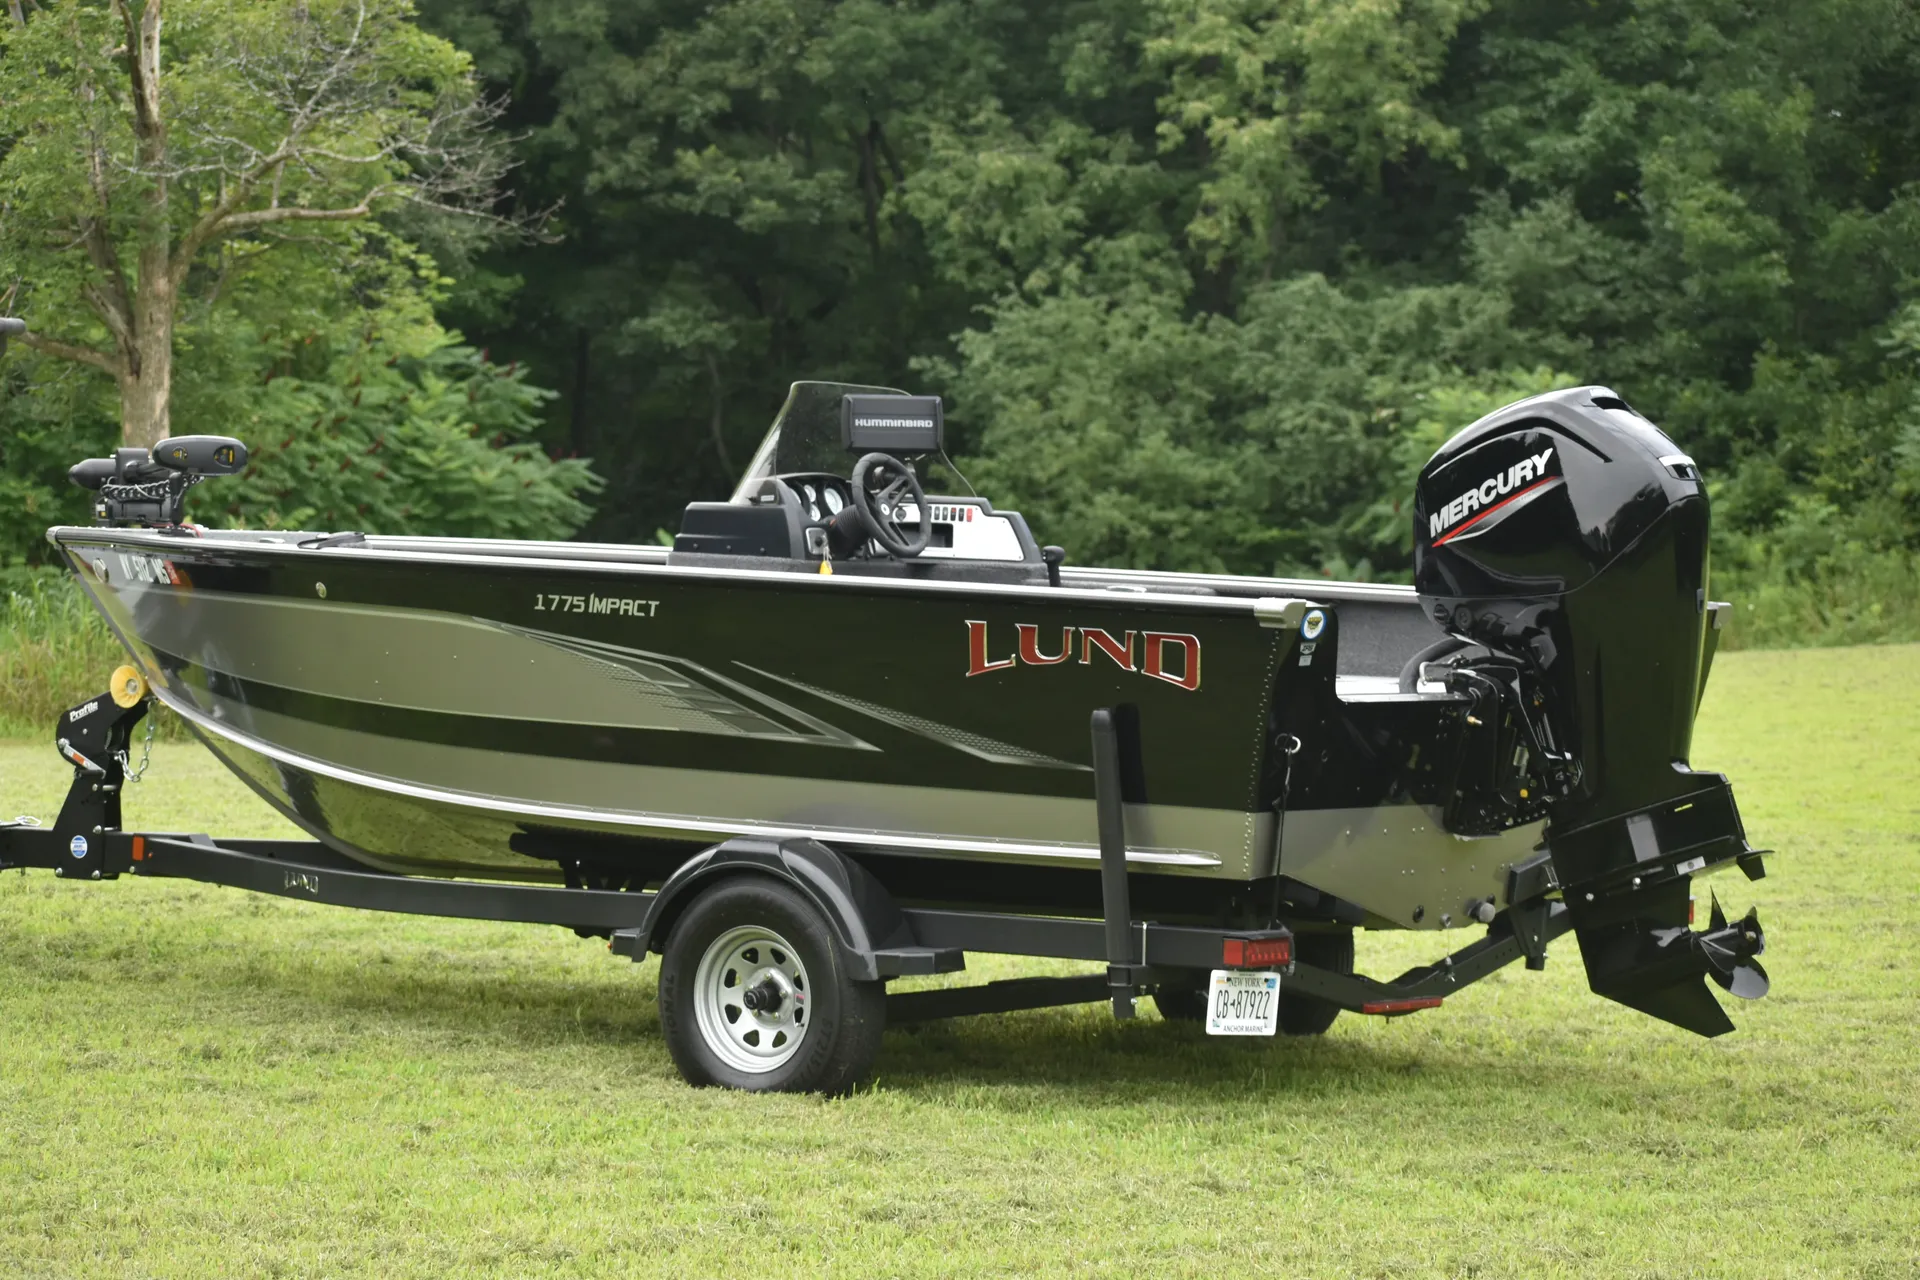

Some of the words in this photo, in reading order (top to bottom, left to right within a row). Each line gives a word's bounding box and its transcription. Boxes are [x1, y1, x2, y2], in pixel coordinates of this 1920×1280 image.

[855, 418, 934, 428] HUMMINBIRD
[1430, 447, 1554, 538] MERCURY
[534, 594, 586, 613] 1775
[588, 592, 660, 617] IMPACT
[965, 620, 1201, 690] LUND
[284, 870, 319, 896] LUND
[1229, 976, 1243, 987] NEW
[1244, 976, 1262, 988] YORK
[1223, 1025, 1245, 1033] ANCHOR
[1245, 1025, 1263, 1033] MARINE
